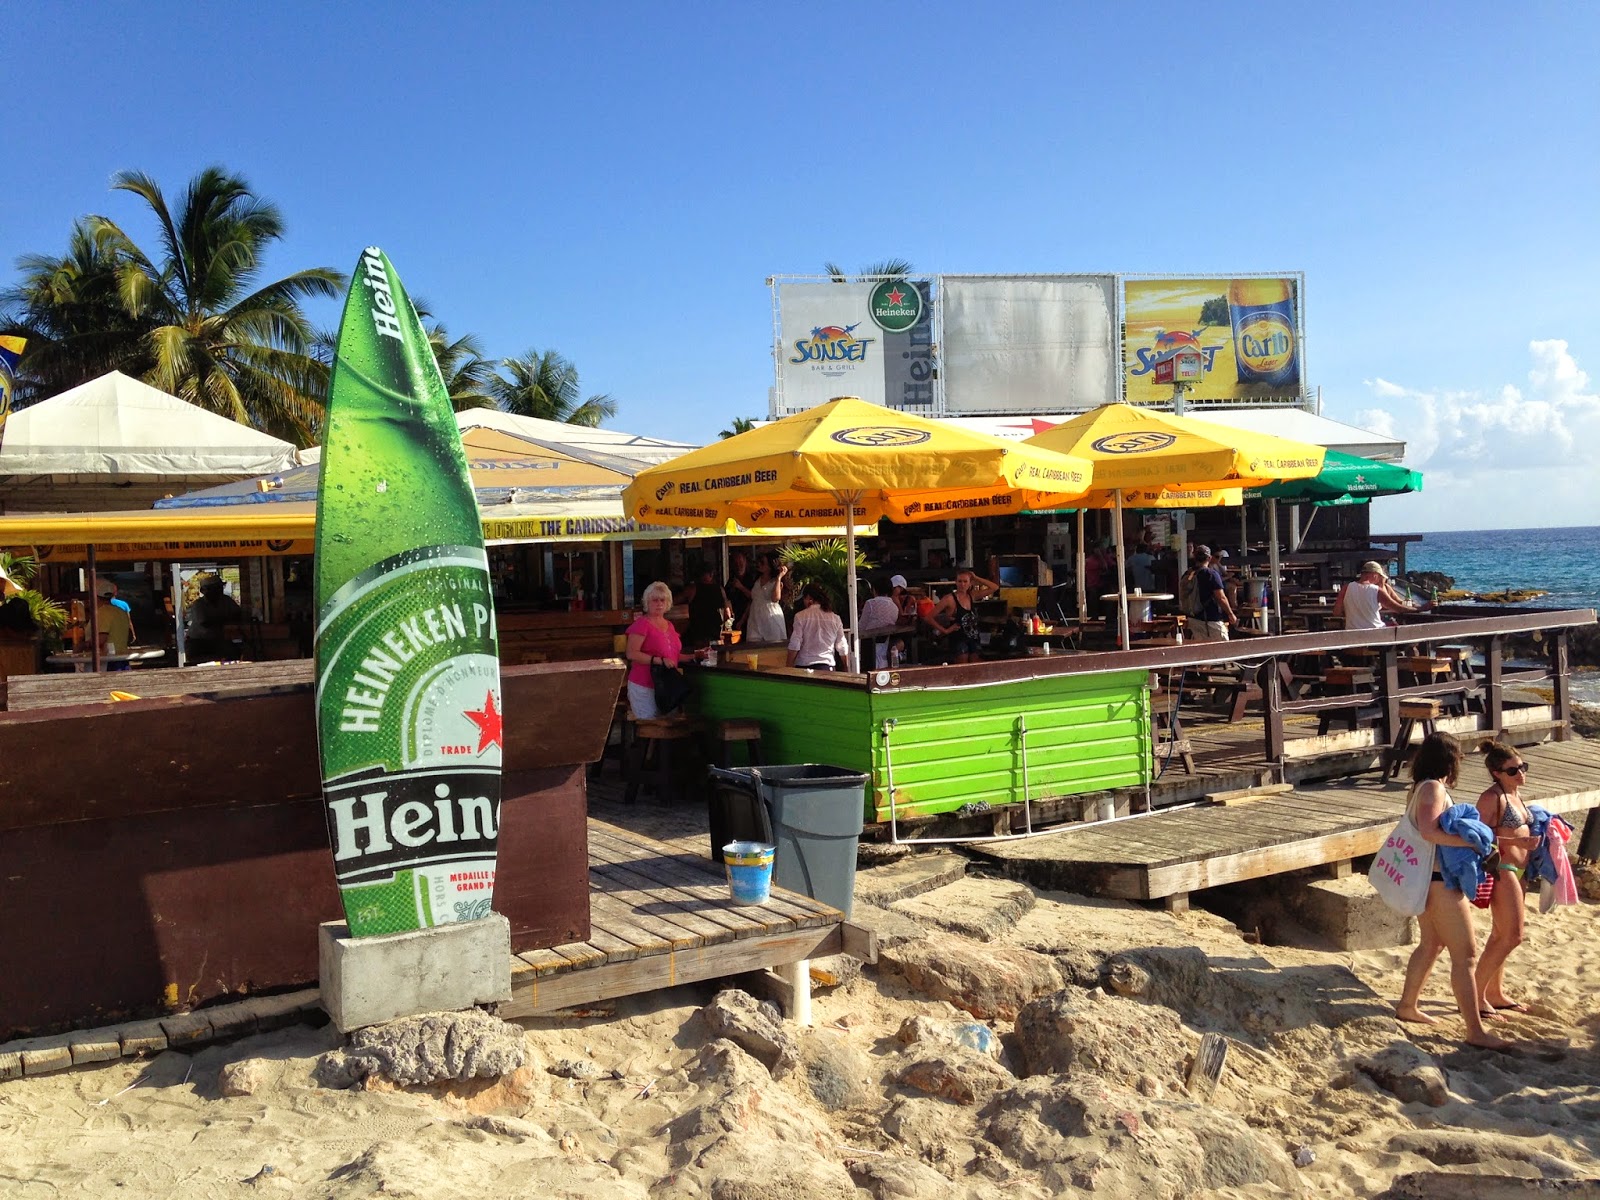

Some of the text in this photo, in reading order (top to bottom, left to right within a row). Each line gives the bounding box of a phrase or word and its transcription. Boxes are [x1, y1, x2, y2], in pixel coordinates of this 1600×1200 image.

[876, 307, 917, 318] Heineken
[790, 338, 876, 364] SUNSET
[1242, 331, 1288, 358] Carib
[680, 481, 704, 494] REAL
[704, 473, 752, 490] CARIBBEAN
[755, 469, 777, 483] BEER
[1042, 468, 1070, 480] CARIBBEAN
[1071, 471, 1082, 482] BEER
[1161, 489, 1196, 499] CARIBBEAN
[1198, 490, 1213, 498] BEER
[946, 499, 989, 510] CARIBBEAN
[992, 495, 1012, 506] BEER
[674, 507, 704, 518] CARIBBEAN
[774, 509, 797, 519] REAL
[798, 508, 846, 518] CARIBBEAN
[848, 507, 867, 516] EER
[495, 520, 539, 538] DRINK.
[540, 520, 562, 536] THE
[566, 517, 635, 535] CARIBBEAN
[340, 603, 467, 733] HEINEKEN
[441, 745, 472, 755] TRADE
[329, 783, 500, 861] Hein
[1386, 836, 1419, 867] SURF
[450, 871, 487, 882] MEDAILLE
[1376, 857, 1405, 886] PINK
[457, 881, 485, 892] GRAND
